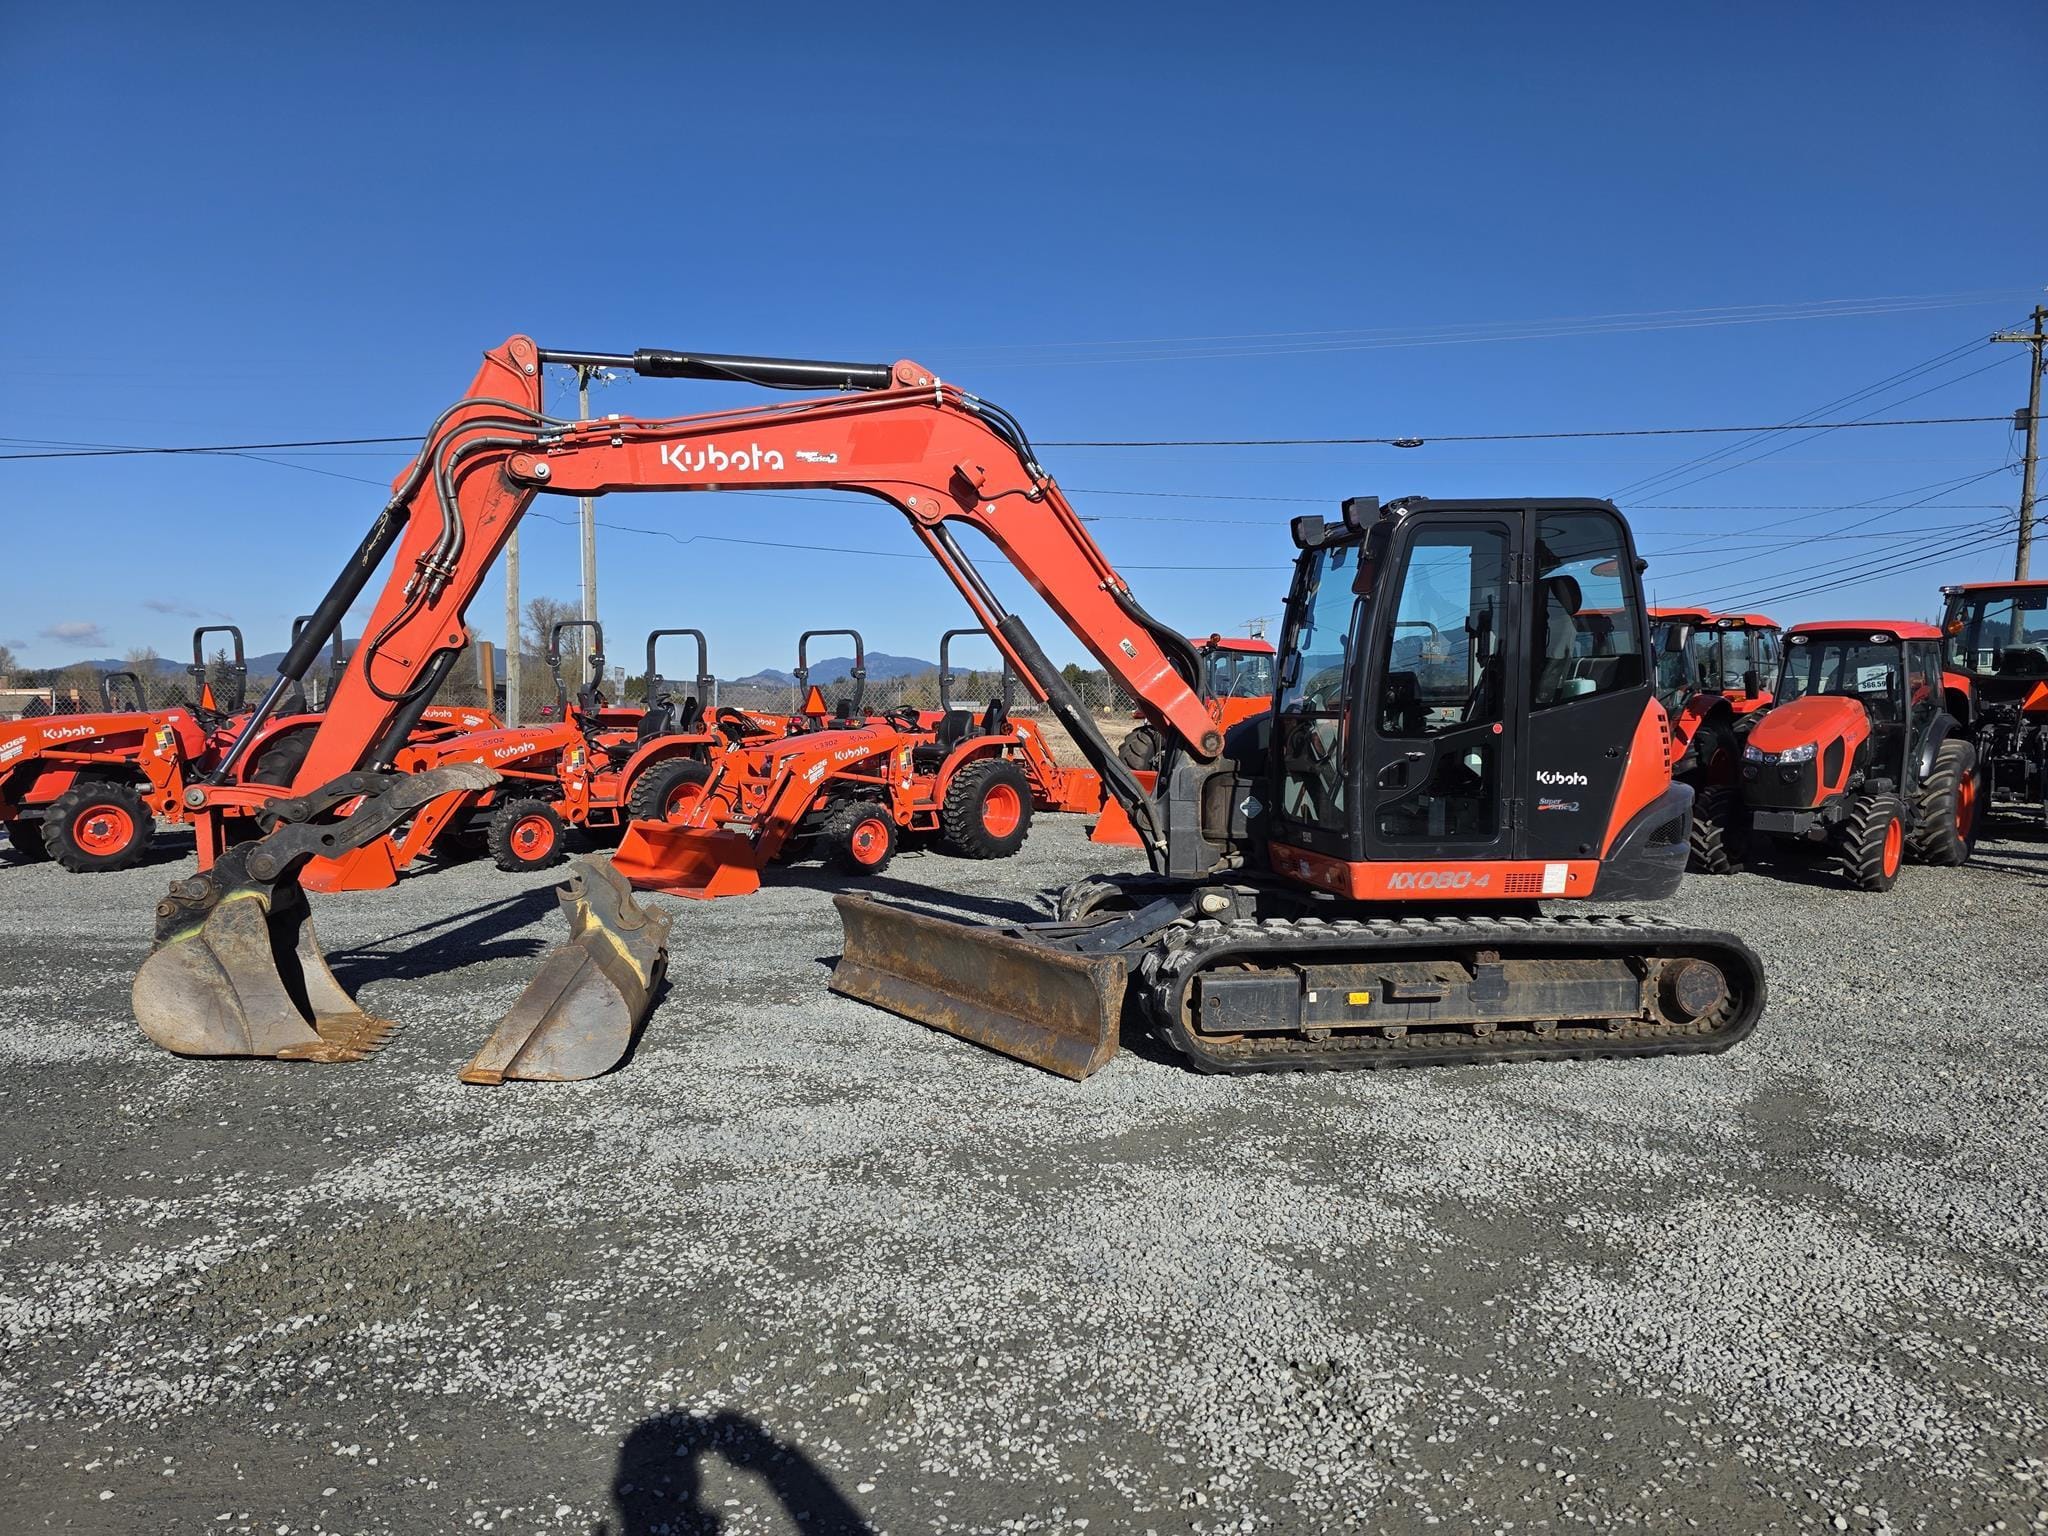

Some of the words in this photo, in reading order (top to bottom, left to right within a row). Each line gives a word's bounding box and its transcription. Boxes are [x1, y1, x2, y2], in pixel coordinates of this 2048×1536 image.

[660, 443, 784, 472] Kubota
[43, 725, 96, 740] Kubota
[494, 742, 536, 759] Kubota
[834, 746, 870, 761] Kubota
[1536, 770, 1588, 786] Kubota
[1386, 870, 1491, 890] KX080-4
